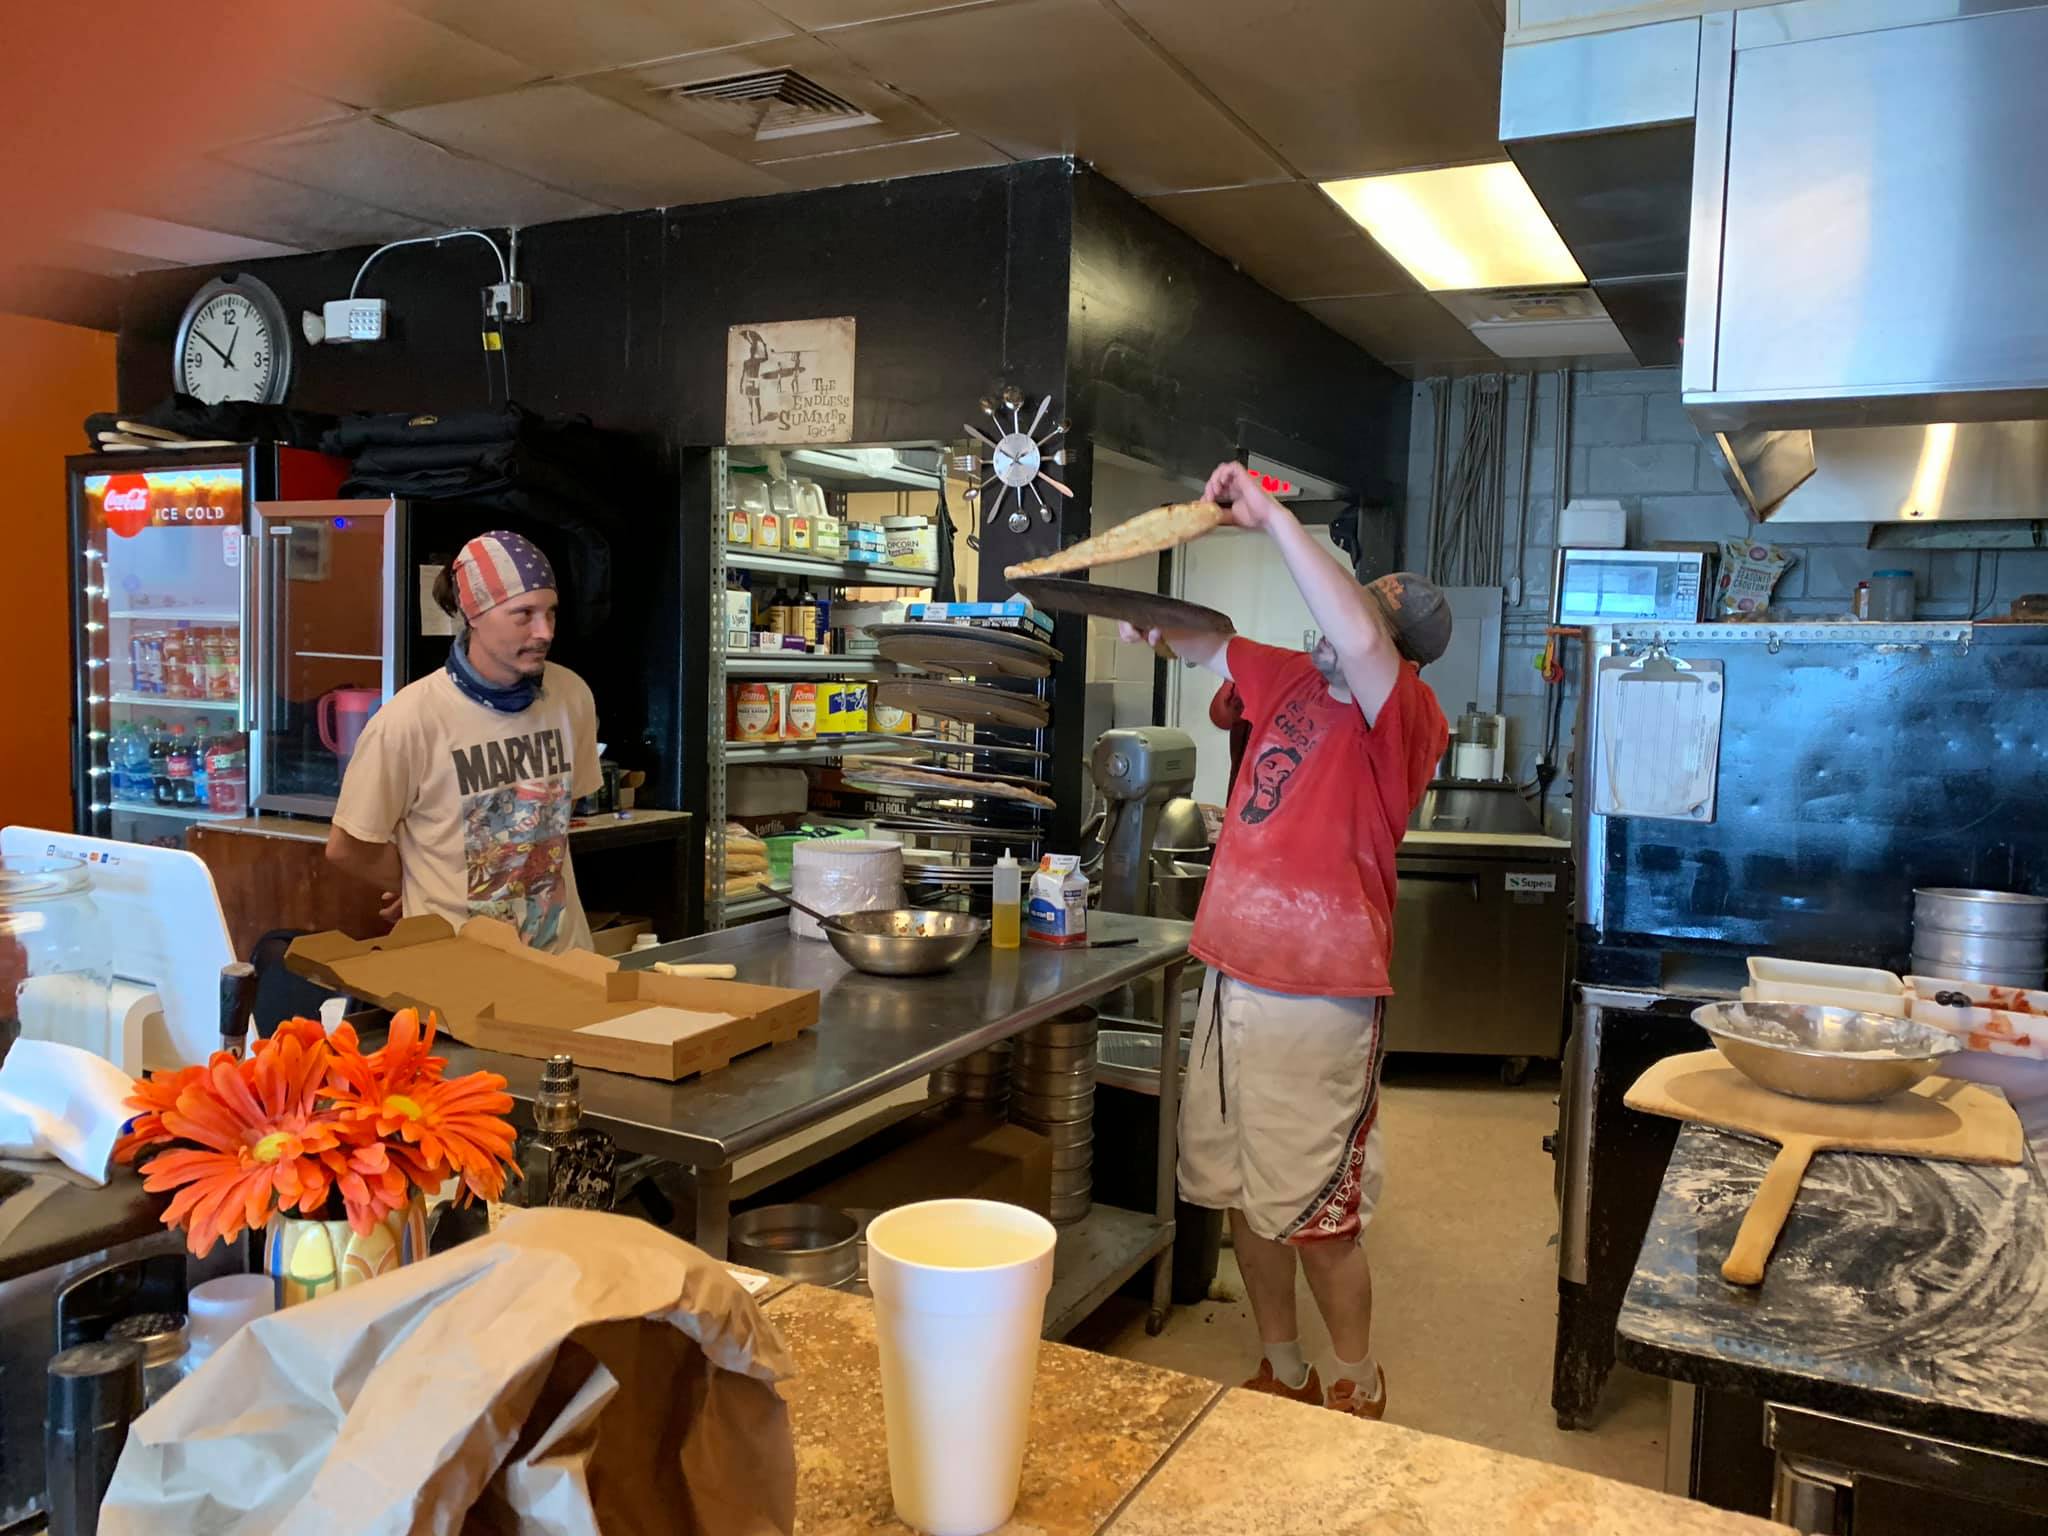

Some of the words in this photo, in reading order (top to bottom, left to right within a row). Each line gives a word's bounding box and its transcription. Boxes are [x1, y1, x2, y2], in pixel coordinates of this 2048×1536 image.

[222, 309, 237, 325] 12
[194, 352, 203, 368] 9
[253, 351, 263, 368] 3
[811, 378, 836, 394] THE
[792, 395, 850, 410] ENDLESS
[778, 409, 847, 431] SUMMER
[155, 507, 179, 520] ICE
[185, 506, 225, 519] COLD
[887, 538, 919, 549] OPCORN
[452, 728, 571, 795] MARVEL
[865, 801, 884, 813] FILM
[885, 802, 906, 815] ROLL
